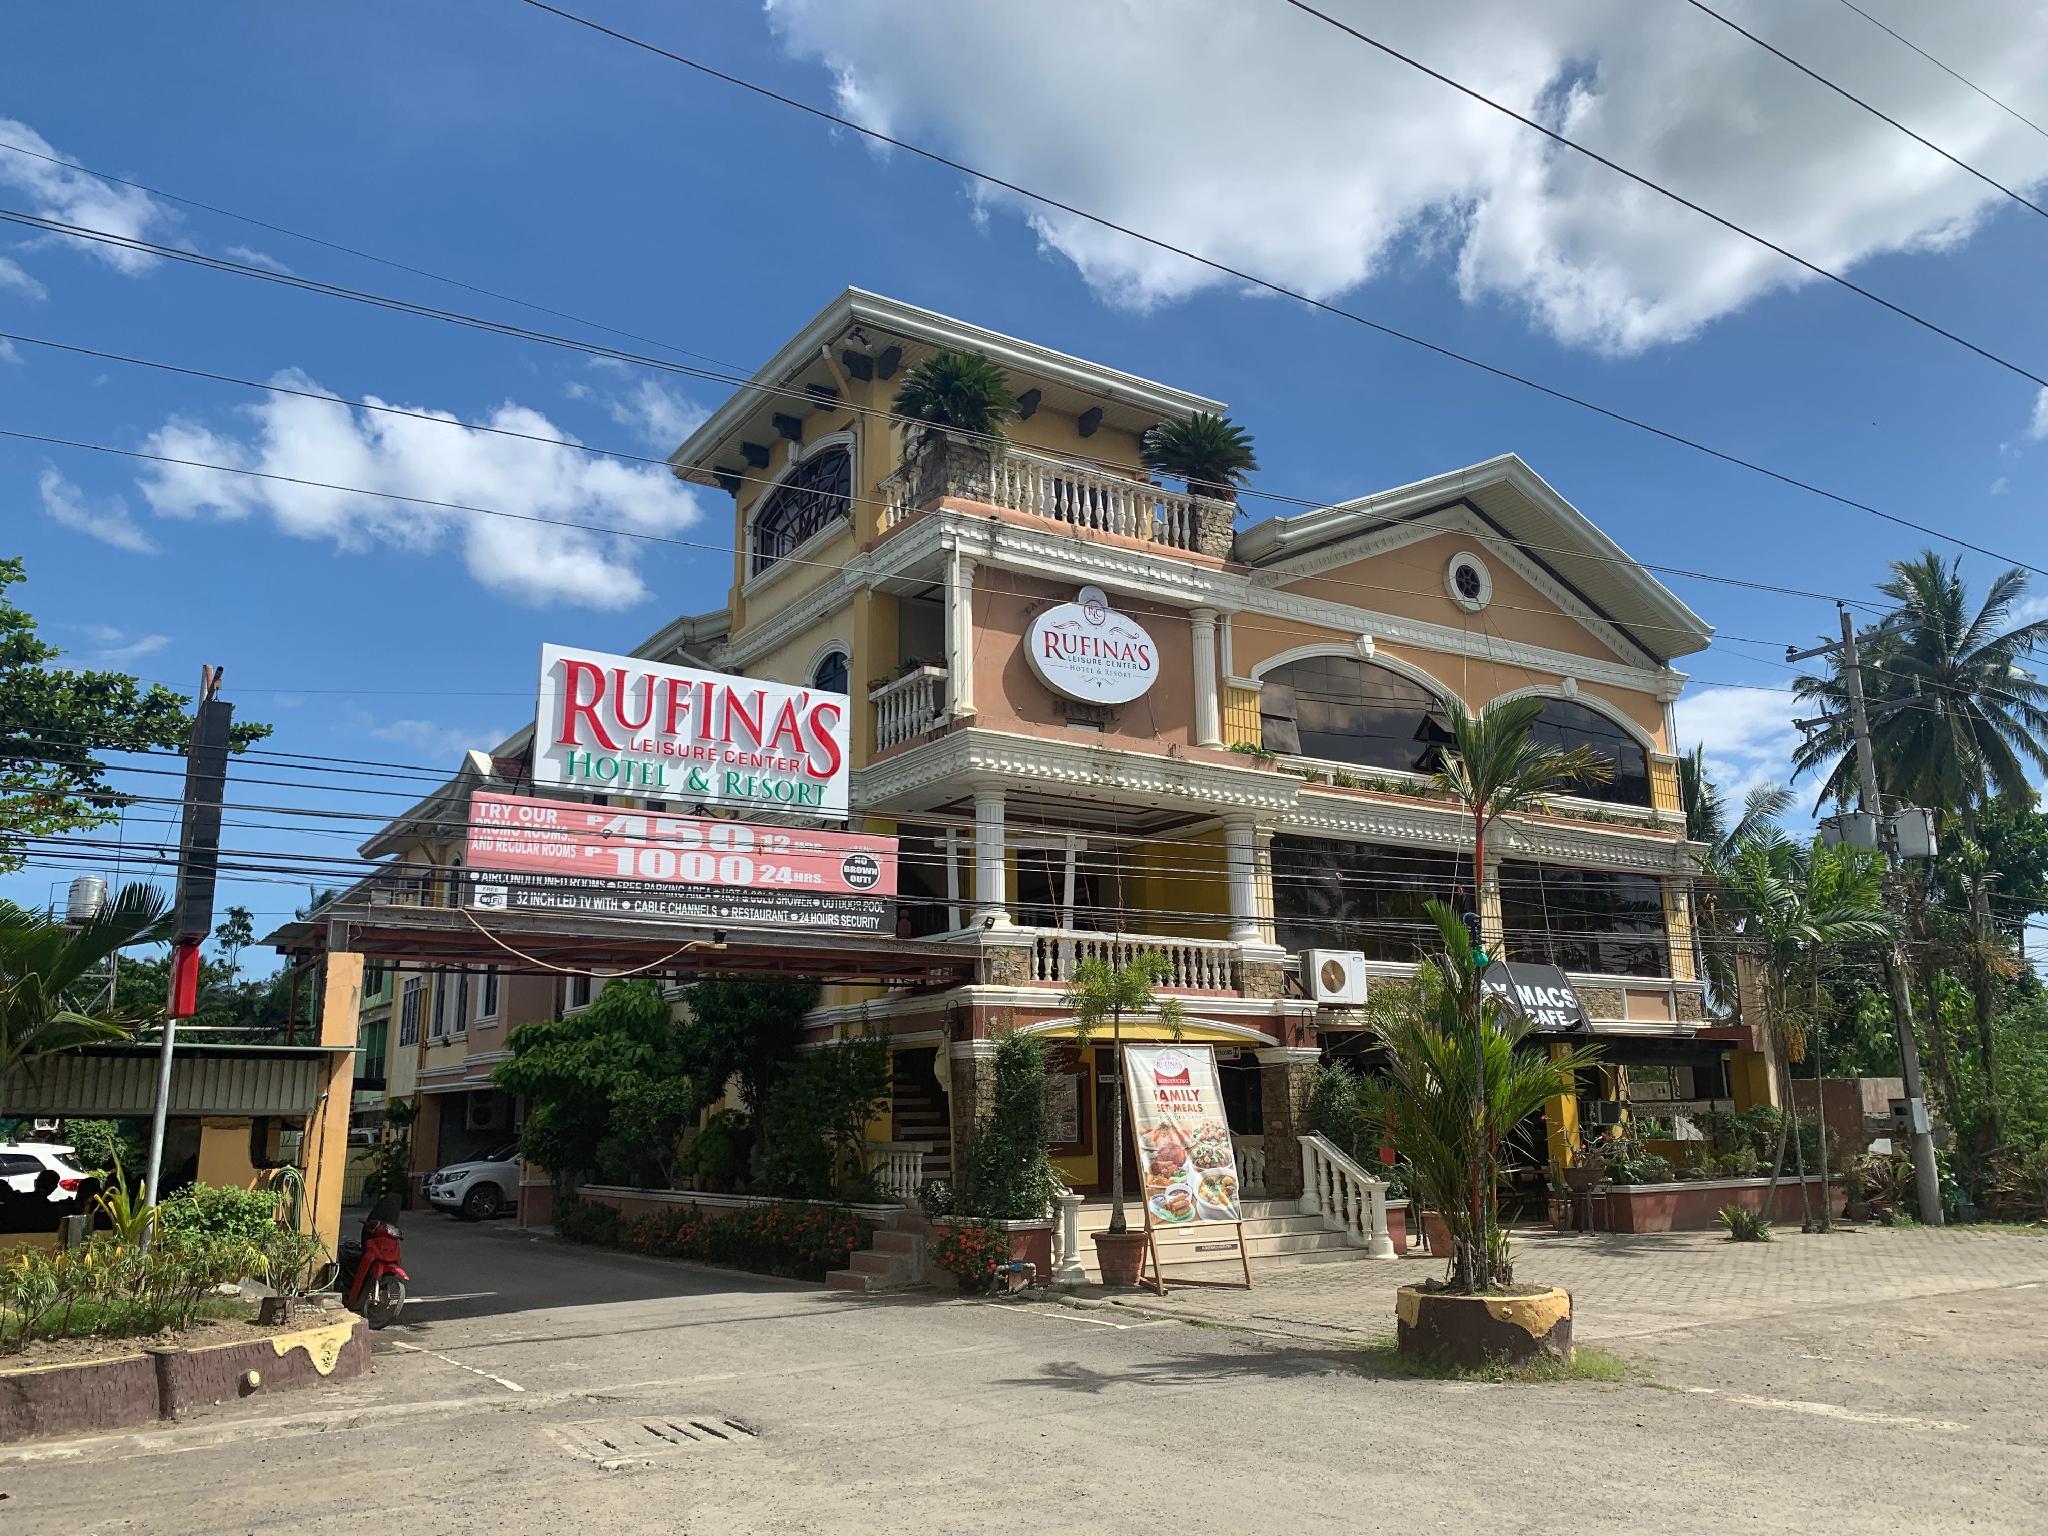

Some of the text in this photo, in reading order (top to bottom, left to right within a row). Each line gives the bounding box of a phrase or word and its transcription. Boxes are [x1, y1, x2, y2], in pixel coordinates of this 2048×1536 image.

[1043, 630, 1151, 671] RUFINA'S
[1068, 655, 1137, 670] LEISURE CENTER
[1069, 664, 1094, 674] HOTEL
[1105, 669, 1131, 679] RESORT
[556, 658, 841, 778] RUFINA'S
[629, 737, 800, 773] LEISURE CENTER
[567, 751, 828, 806] HOTEL & RESORT
[478, 802, 558, 824] TRY OUR
[474, 818, 521, 836] PROMO
[472, 835, 577, 858] AND REGULAR ROOMS
[760, 830, 791, 855] 12
[843, 865, 878, 876] BROWN
[854, 856, 868, 865] NO
[481, 873, 568, 887] AIRCONDITIONED
[850, 875, 872, 884] OUT!
[516, 891, 880, 930] 32 INCH LED TV WITH CABLE CHANNELS RESTAURANT 24 HOURS SECURITY
[1515, 984, 1577, 1009] MACS
[1153, 1089, 1200, 1102] FAMILY
[1157, 1103, 1204, 1113] SET MEALS
